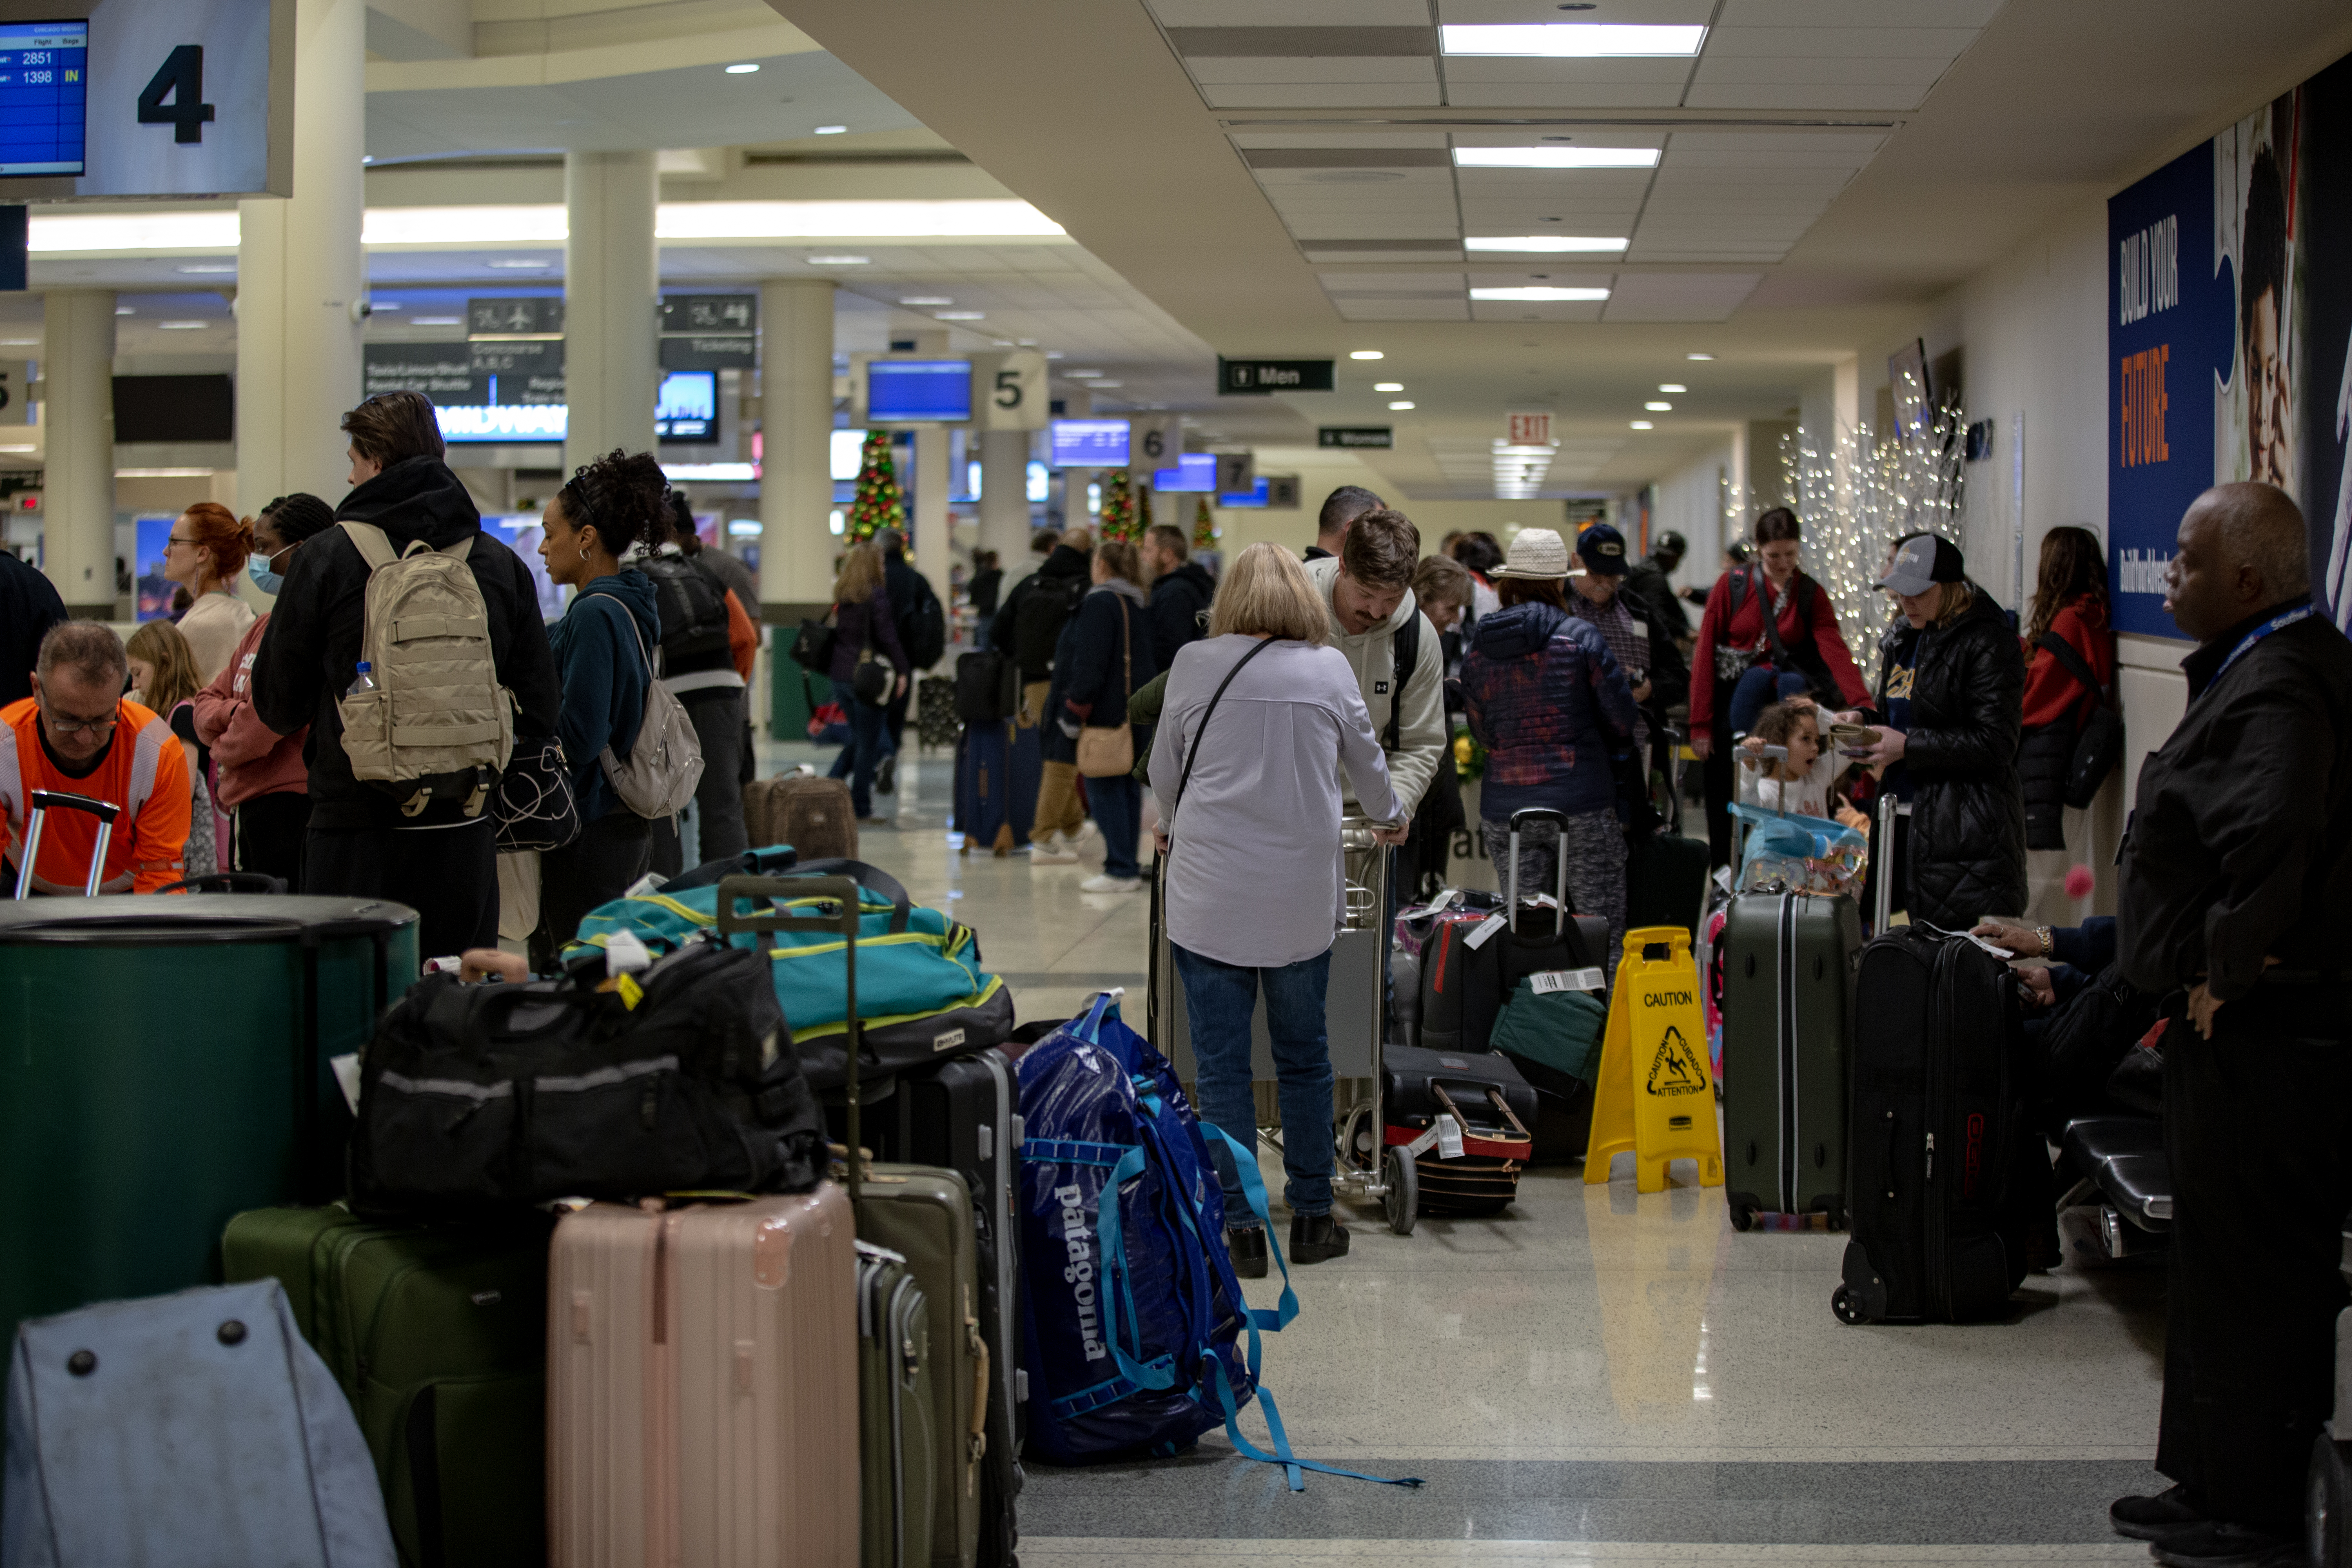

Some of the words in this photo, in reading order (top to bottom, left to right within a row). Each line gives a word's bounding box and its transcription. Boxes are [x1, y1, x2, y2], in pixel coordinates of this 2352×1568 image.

[34, 38, 52, 47] Flight
[62, 38, 79, 46] Bags
[23, 51, 51, 65] 2851
[23, 70, 53, 84] 1398
[65, 69, 79, 83] IN
[138, 45, 215, 143] 4
[2120, 229, 2149, 326] BUILD
[2149, 214, 2178, 314] YOUR
[994, 370, 1022, 408] 5
[1258, 368, 1301, 385] Men
[2121, 344, 2169, 468] FUTURE
[1511, 415, 1549, 440] EXIT
[1144, 430, 1165, 458] 6
[1230, 463, 1243, 485] 7
[1644, 991, 1693, 1007] CAUTION
[1648, 1039, 1669, 1080] CAUTION
[1679, 1038, 1703, 1077] CUIDADO
[1657, 1085, 1699, 1098] ATTENTION
[1054, 1183, 1107, 1362] patagonia
